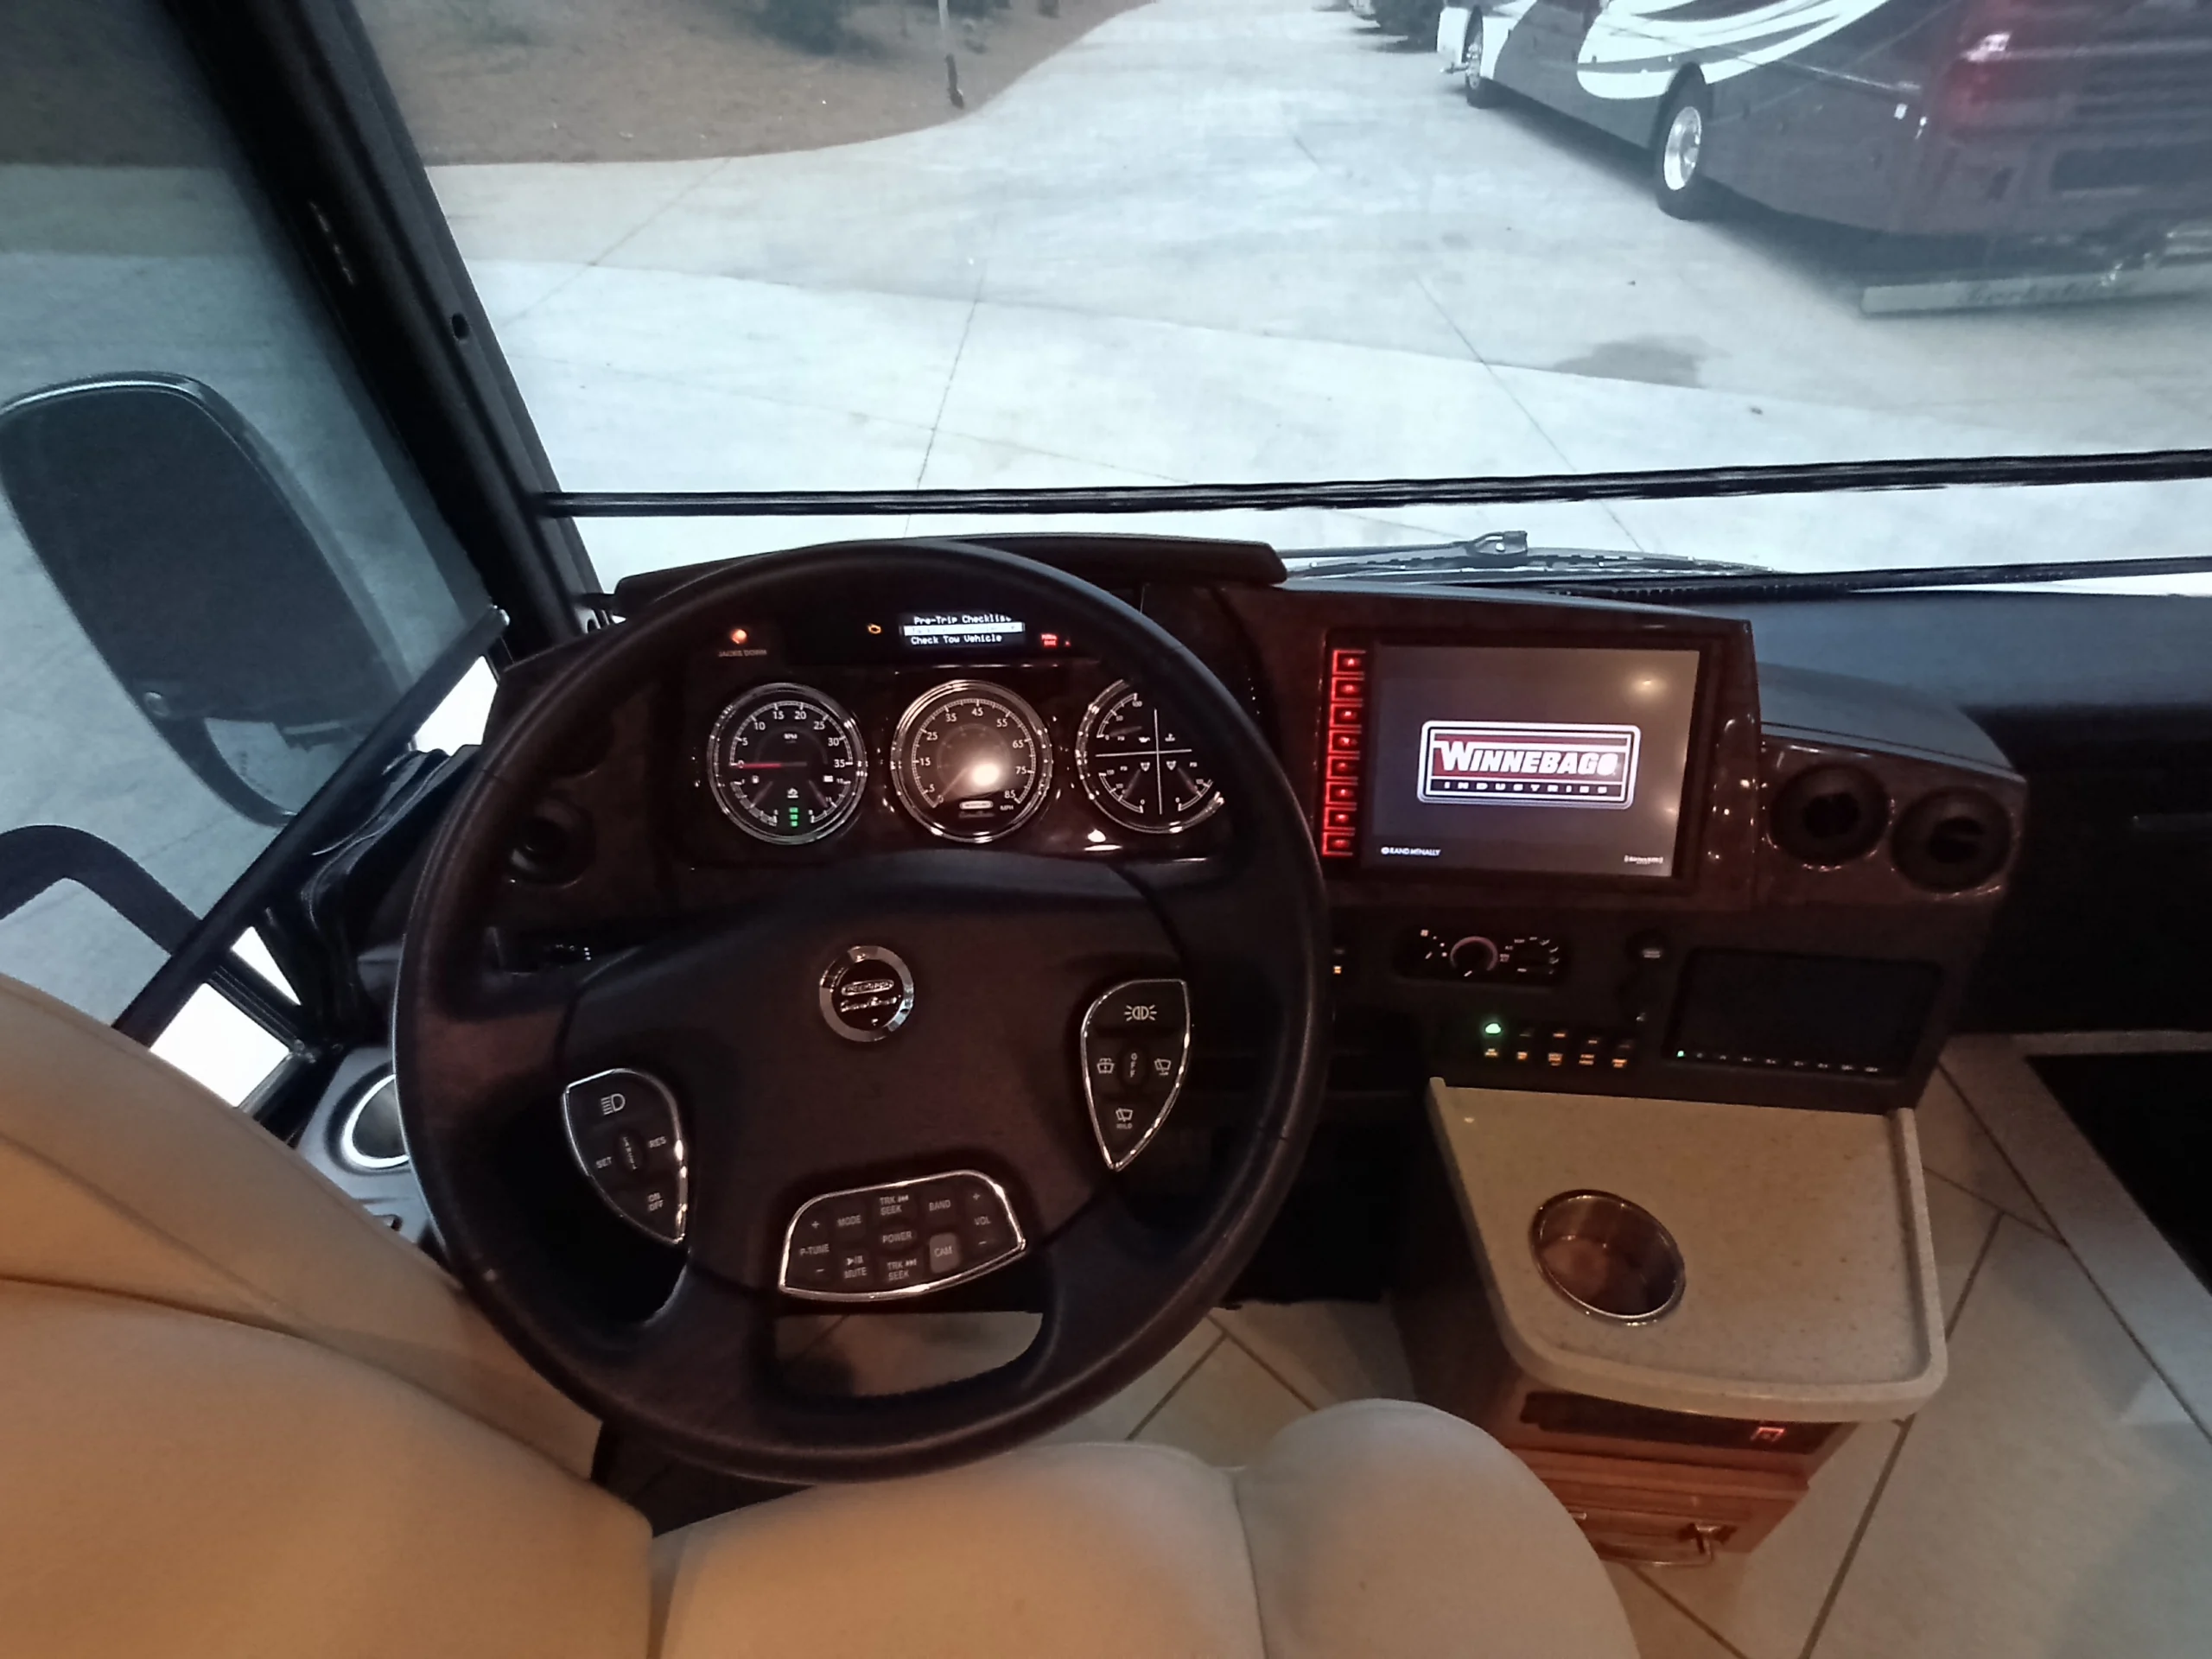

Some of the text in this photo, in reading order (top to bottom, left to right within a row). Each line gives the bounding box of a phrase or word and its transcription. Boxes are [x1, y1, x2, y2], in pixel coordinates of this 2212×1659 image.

[914, 615, 957, 625] Pre-Trip
[911, 633, 1002, 645] Check Tow Vehicle
[794, 711, 807, 720] 20
[971, 708, 984, 716] 45
[945, 713, 957, 722] 35
[754, 721, 766, 730] 10
[813, 721, 825, 730] 25
[996, 719, 1008, 728] 55
[926, 732, 938, 741] 25
[742, 738, 748, 747] 5
[828, 738, 840, 747] 30
[1013, 740, 1024, 748] 65
[834, 759, 845, 768] 35
[920, 757, 931, 766] 15
[1435, 741, 1618, 776] WINNEBAGO
[1015, 766, 1027, 775] 75
[929, 784, 935, 793] 5
[1444, 781, 1607, 794] INDUSTRIES
[1004, 790, 1015, 799] 85
[648, 1135, 667, 1149] RES
[596, 1156, 613, 1169] SET
[880, 1195, 896, 1206] TRK
[929, 1199, 951, 1211] BAND
[880, 1205, 902, 1216] SEEK
[836, 1215, 861, 1227] MODE
[974, 1216, 992, 1226] VOL
[881, 1231, 912, 1243] POWER
[934, 1246, 953, 1257] CAM
[887, 1260, 904, 1270] TRK
[844, 1268, 868, 1279] MUTE
[888, 1270, 910, 1281] SEEK
